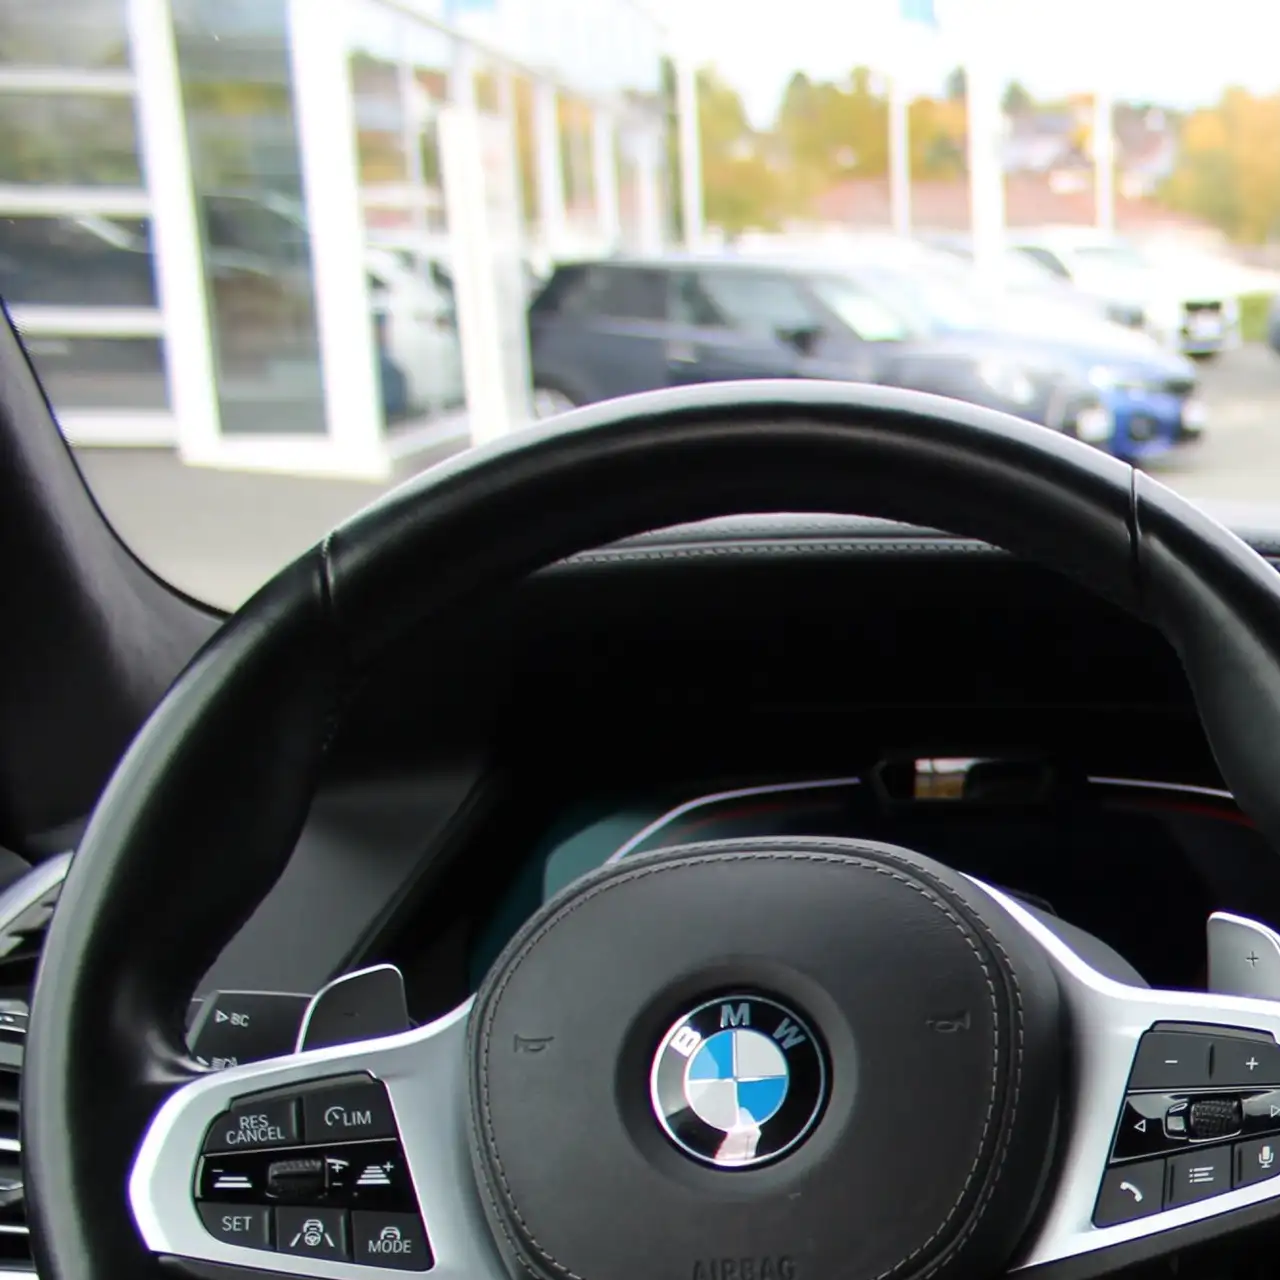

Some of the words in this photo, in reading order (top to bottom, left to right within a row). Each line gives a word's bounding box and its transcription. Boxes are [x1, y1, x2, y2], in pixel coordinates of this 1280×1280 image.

[669, 1002, 807, 1058] BMW
[239, 1114, 269, 1129] RES
[343, 1110, 372, 1126] LIM
[226, 1126, 285, 1145] CANCEL
[222, 1216, 252, 1232] SET
[368, 1240, 412, 1254] MODE
